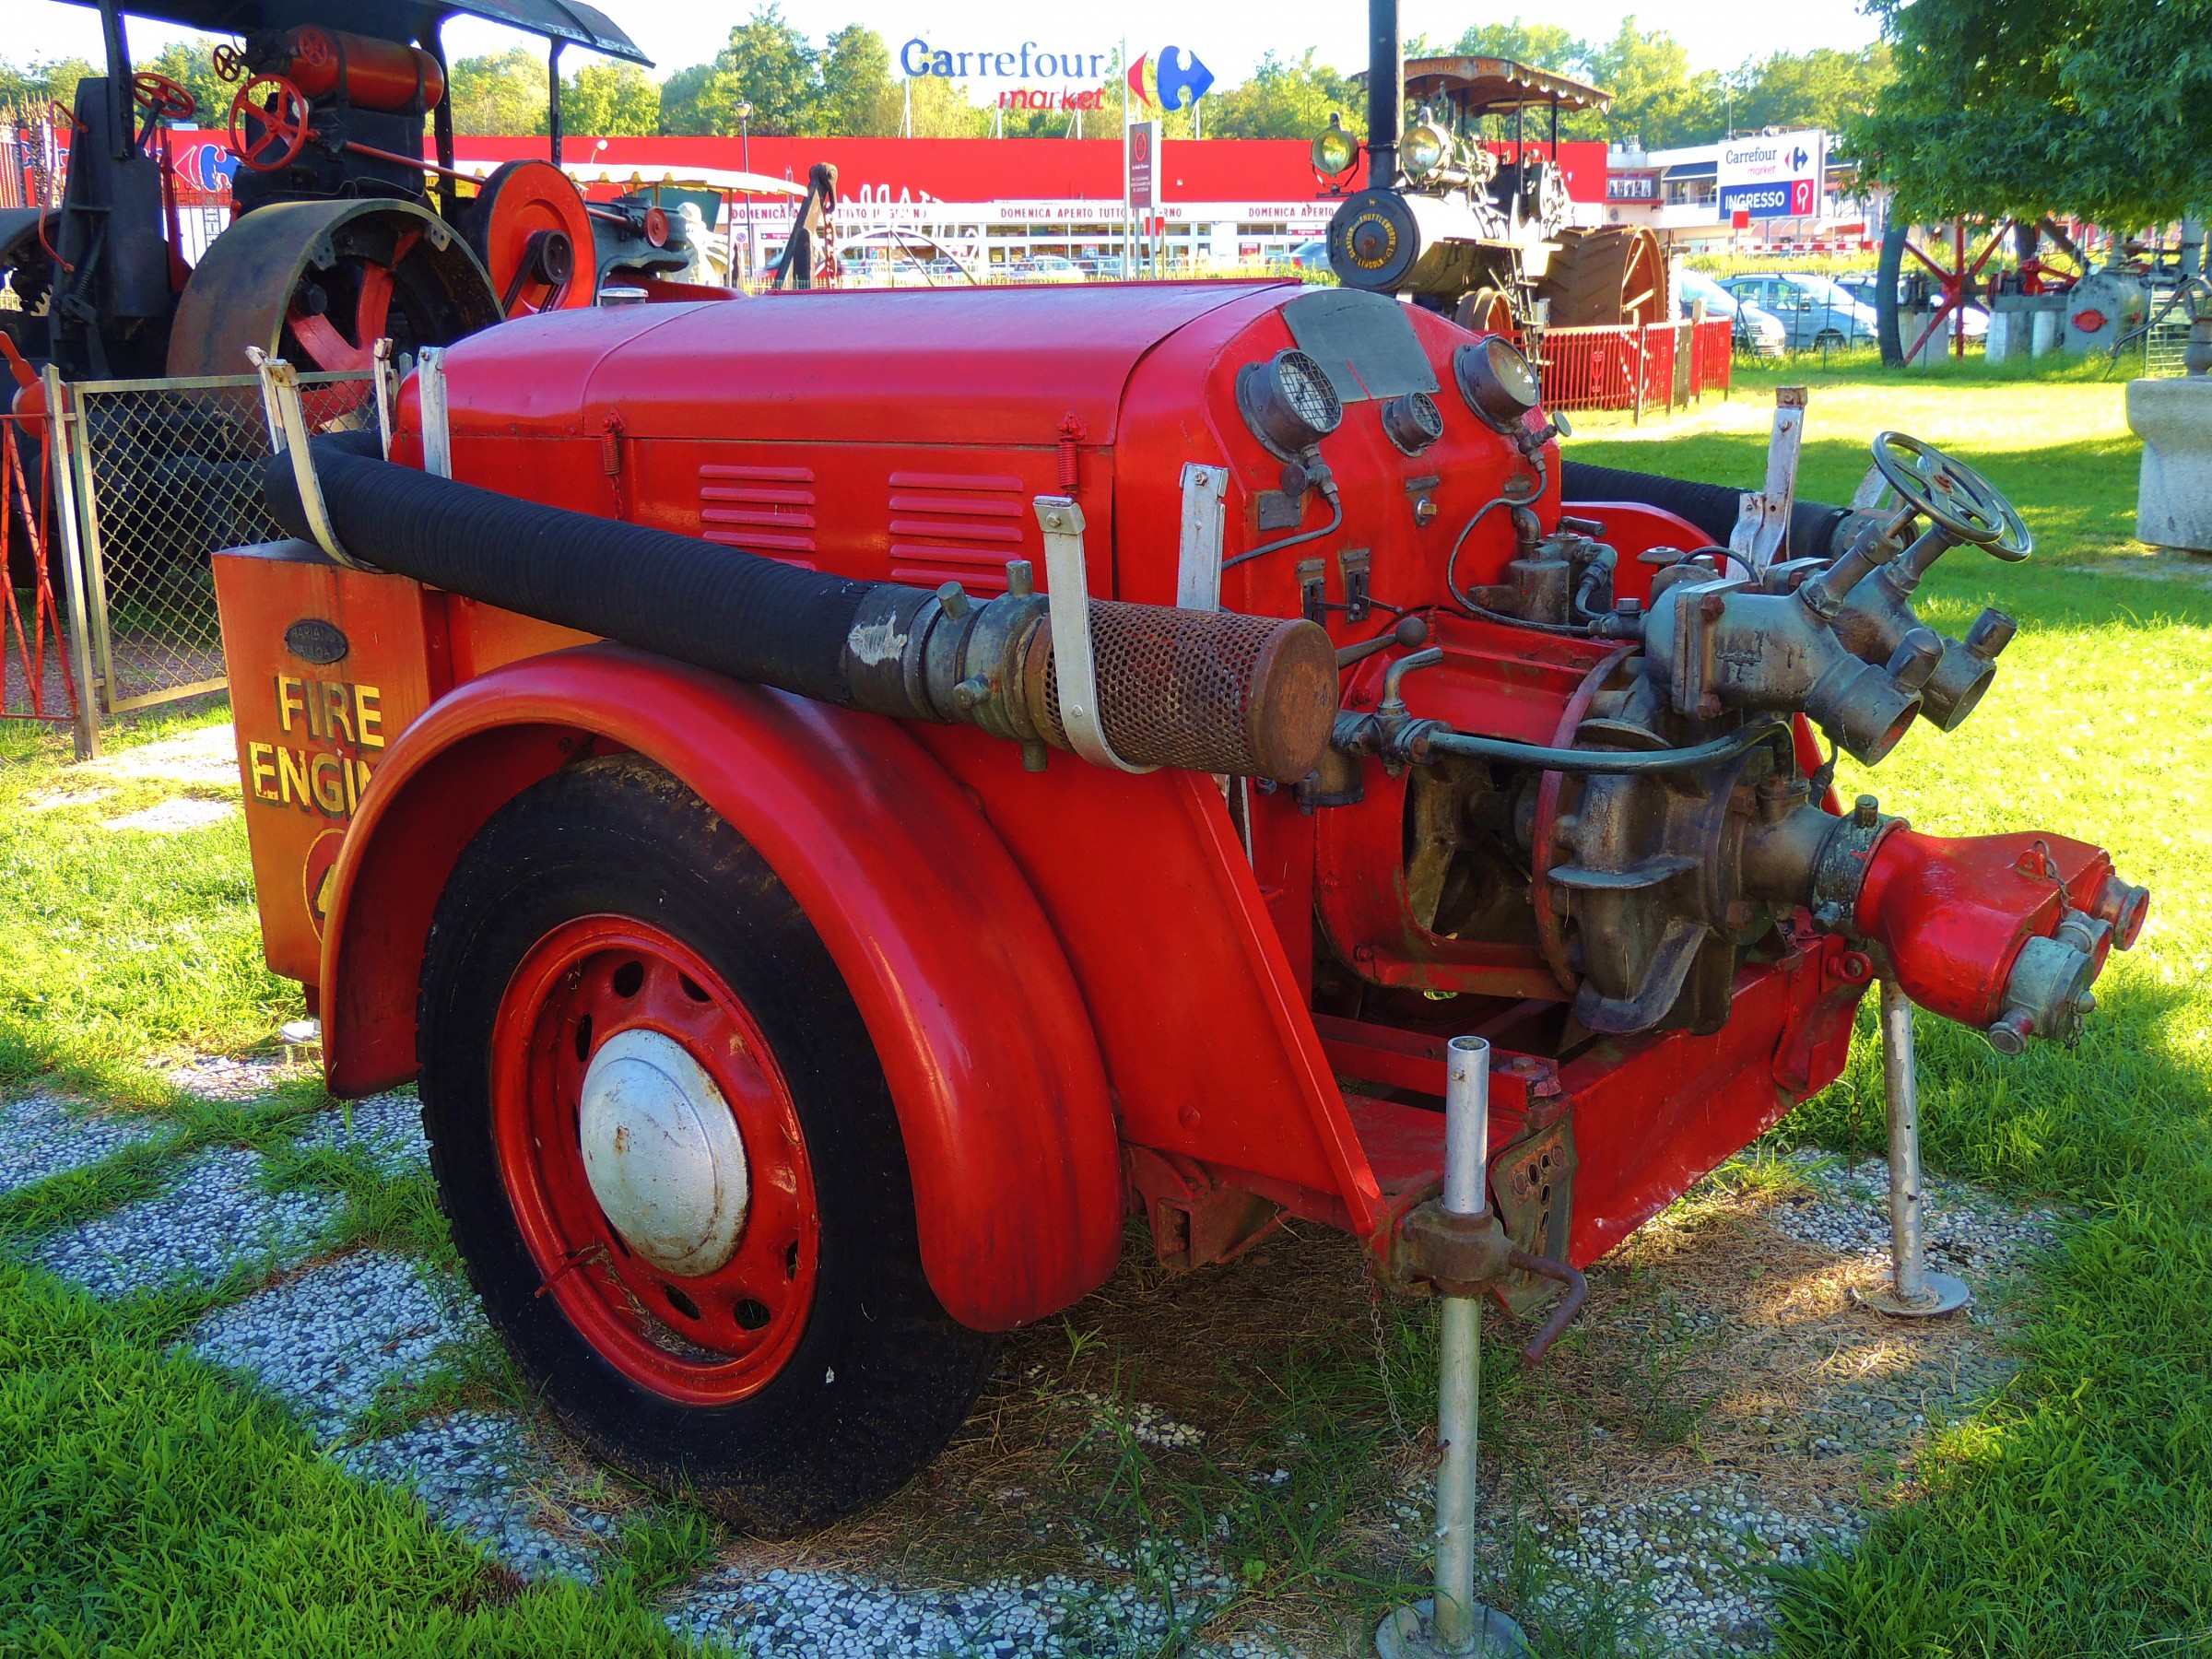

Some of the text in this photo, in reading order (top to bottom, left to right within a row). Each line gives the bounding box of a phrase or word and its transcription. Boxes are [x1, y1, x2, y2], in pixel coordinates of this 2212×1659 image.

[900, 38, 1105, 79] Carrefour
[997, 85, 1105, 111] market
[1725, 147, 1777, 164] Carrefour
[1747, 165, 1776, 175] market
[1725, 191, 1785, 210] INGRESSO
[1001, 208, 1051, 218] DOMENICA
[1057, 208, 1093, 218] APERTO
[1249, 207, 1335, 218] DOMENICA APERTO
[1346, 227, 1357, 259] CLAYTON
[1359, 213, 1396, 245] SHUTTLEWORTH
[1358, 258, 1385, 269] LINCOLN
[276, 676, 385, 750] FIRE
[248, 741, 378, 818] ENGIN
